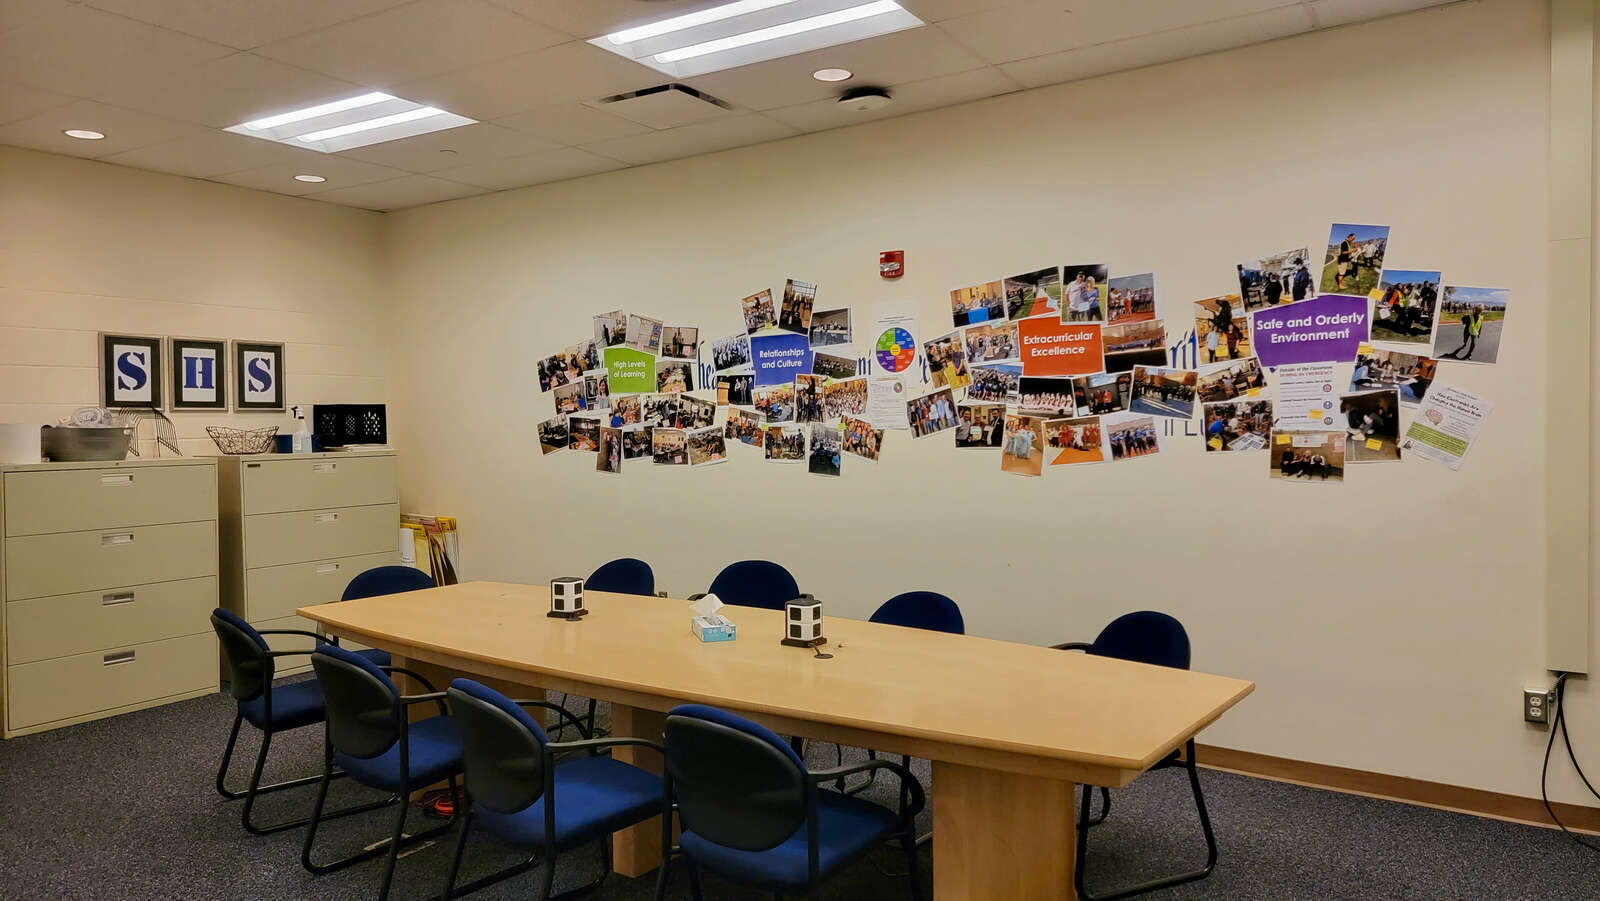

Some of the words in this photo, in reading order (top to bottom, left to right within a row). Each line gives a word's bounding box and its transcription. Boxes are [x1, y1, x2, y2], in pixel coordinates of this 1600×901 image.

[1257, 319, 1283, 330] Safe
[1287, 316, 1312, 328] and
[1316, 312, 1365, 325] Orderly
[1024, 332, 1093, 344] Extracurricular
[1271, 328, 1350, 343] Environment
[760, 348, 804, 358] Relationships
[1032, 346, 1085, 356] Excellence
[613, 360, 627, 369] High
[628, 360, 646, 368] Levels
[761, 360, 776, 368] and
[777, 360, 802, 368] Culture
[117, 352, 147, 391] S
[184, 356, 214, 389] H
[248, 357, 272, 392] S
[613, 370, 620, 378] of
[621, 370, 646, 379] Learning
